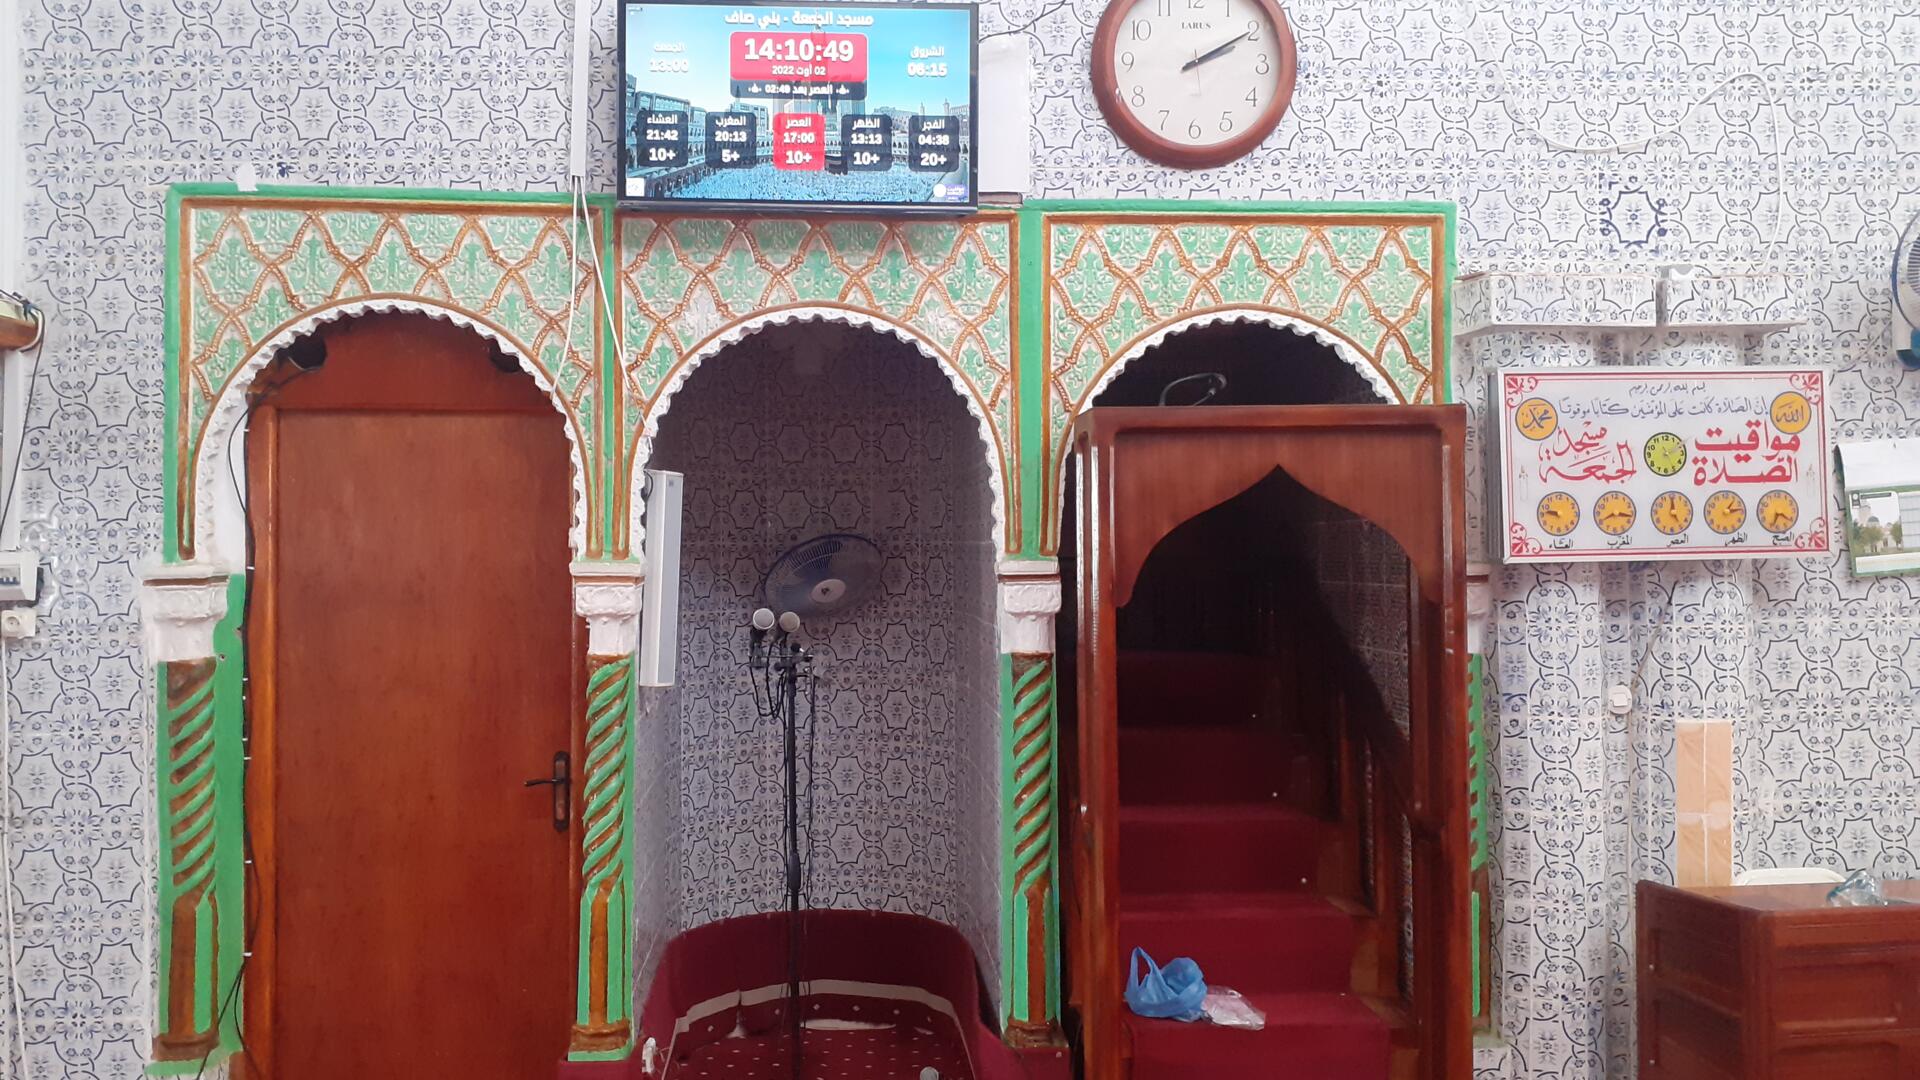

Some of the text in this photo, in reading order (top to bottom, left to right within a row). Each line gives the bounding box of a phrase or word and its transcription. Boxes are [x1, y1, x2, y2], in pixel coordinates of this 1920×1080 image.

[725, 10, 755, 24] صاف
[792, 11, 833, 27] الجمعة
[836, 14, 874, 27] مسجد
[1132, 19, 1152, 41] 10
[744, 38, 854, 62] 14:10:49
[910, 45, 945, 59] الشروق
[1121, 52, 1134, 73] 9
[1256, 54, 1270, 75] 3
[772, 64, 826, 77] 02 أوت 2022
[907, 63, 948, 77] 06:15
[809, 84, 833, 96] العصر
[1131, 86, 1145, 107] 8
[1245, 87, 1258, 107] 4
[647, 113, 678, 125] العشاء
[715, 115, 746, 128] المغرب
[786, 117, 812, 129] العصر
[852, 118, 880, 130] الظهر
[922, 119, 945, 131] الفجر
[1158, 110, 1170, 131] 7
[1219, 111, 1233, 132] 5
[646, 129, 679, 141] 21:42
[1188, 119, 1202, 140] 6
[715, 131, 747, 143] 20:13
[783, 132, 815, 144] 17:00
[851, 133, 883, 145] 13:13
[1695, 418, 1800, 463] مواقيت
